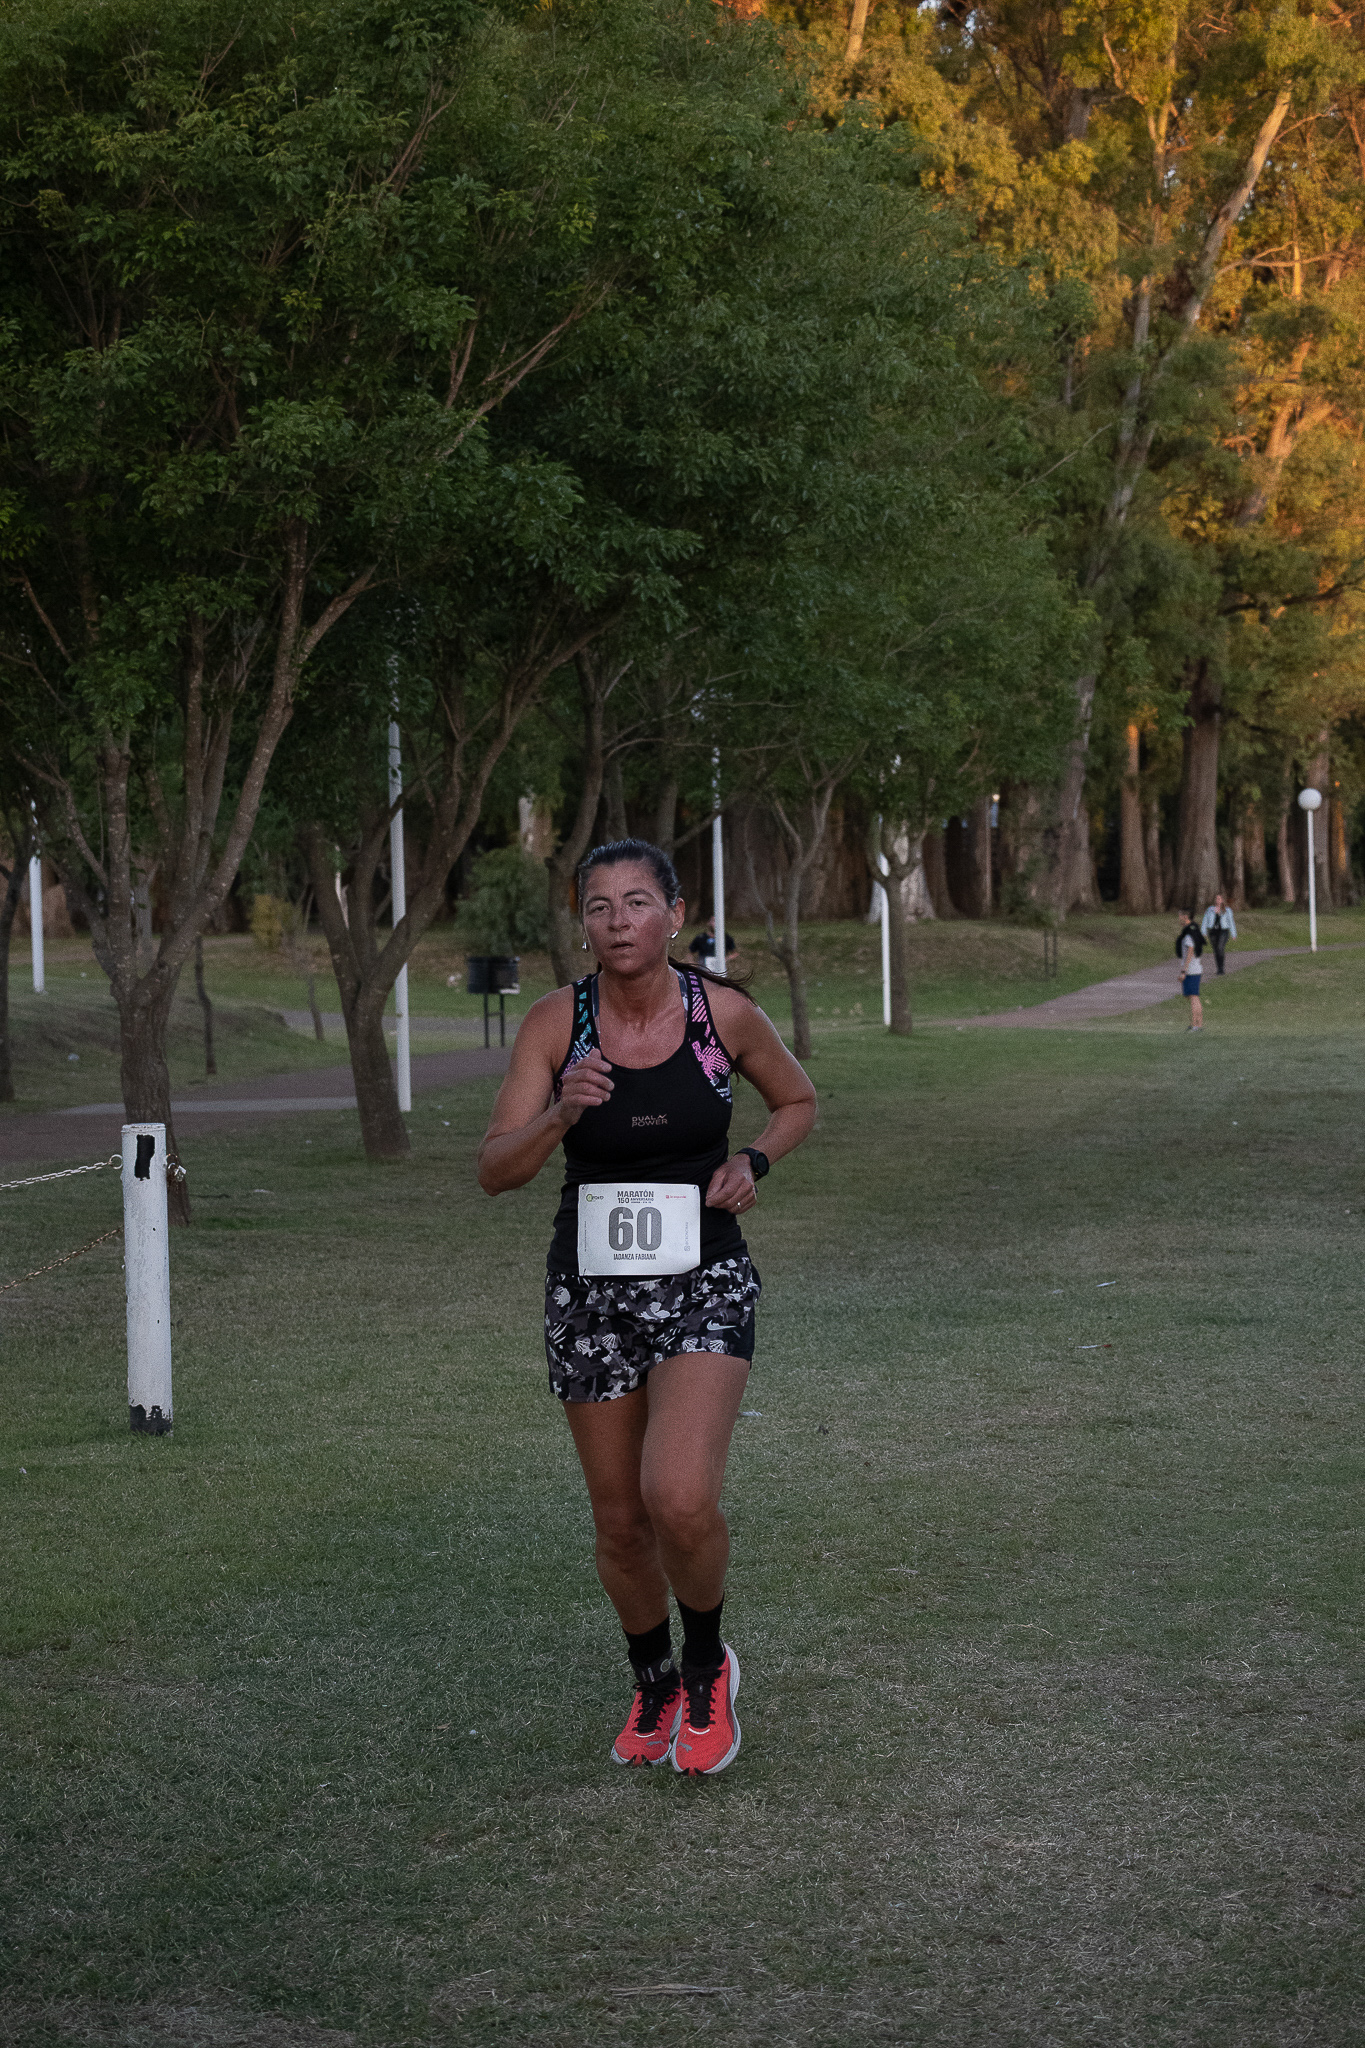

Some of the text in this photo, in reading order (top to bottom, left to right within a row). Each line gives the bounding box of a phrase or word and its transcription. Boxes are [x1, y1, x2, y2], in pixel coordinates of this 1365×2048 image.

[631, 1118, 668, 1128] POWER
[617, 1189, 654, 1198] MARATÓN
[608, 1206, 662, 1252] 60
